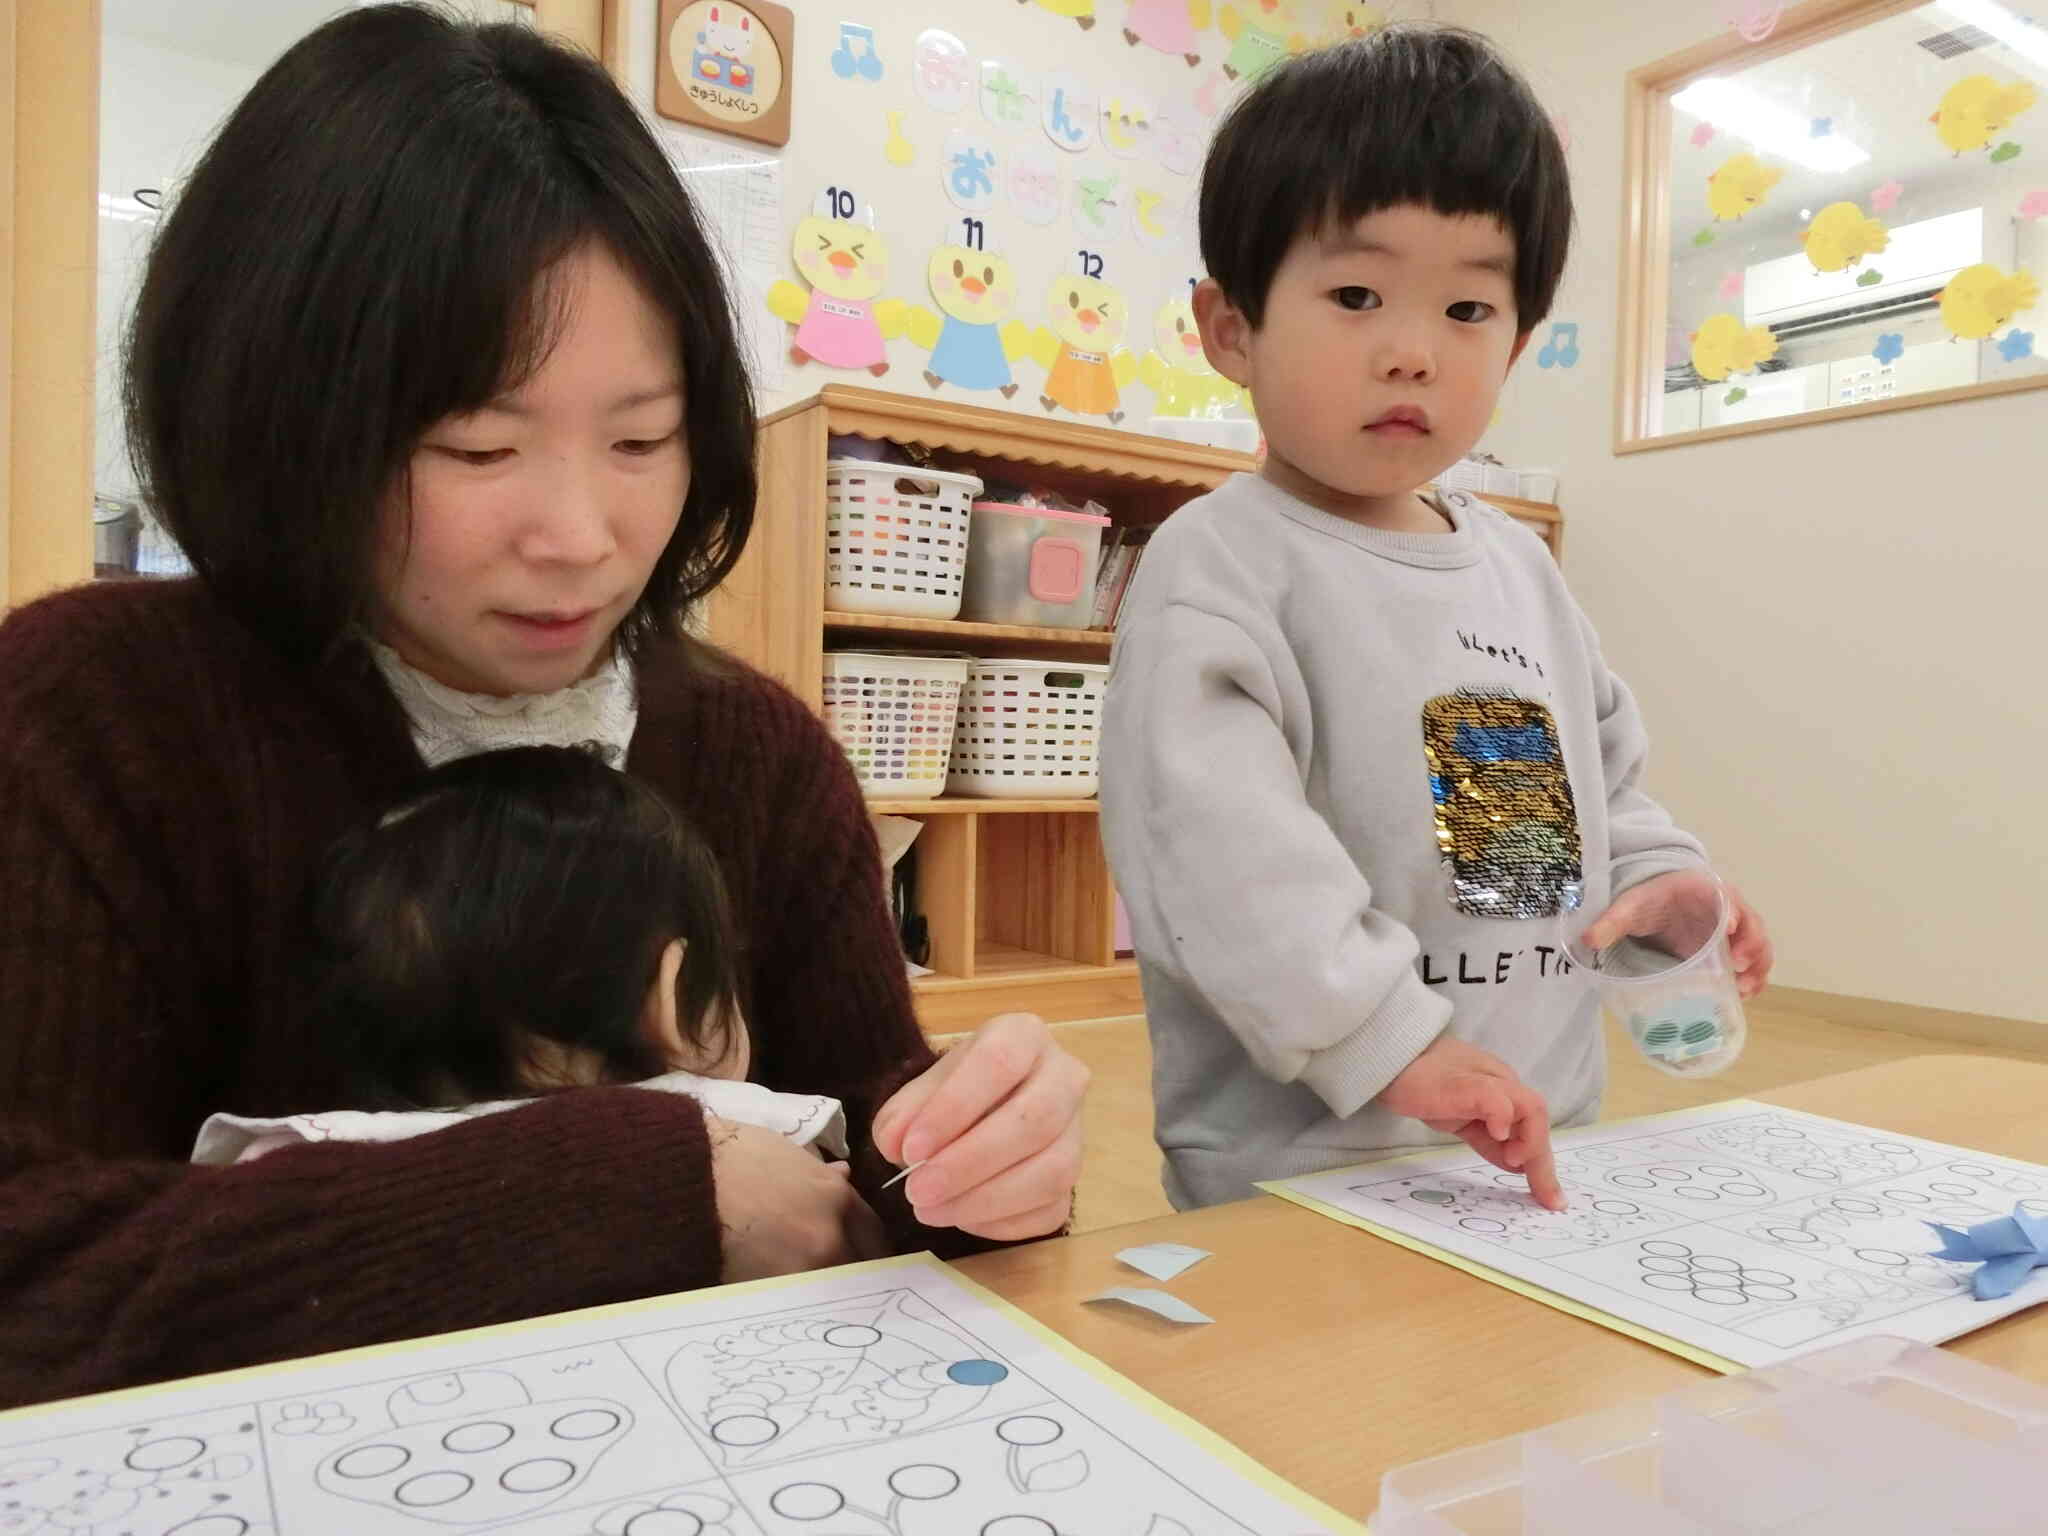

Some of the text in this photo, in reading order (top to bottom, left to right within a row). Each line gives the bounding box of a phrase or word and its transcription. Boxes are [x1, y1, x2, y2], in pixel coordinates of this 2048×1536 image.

[688, 84, 759, 115] きゅうしょくしつ
[826, 185, 856, 220] 10
[962, 216, 984, 252] 11
[1078, 249, 1105, 280] 12
